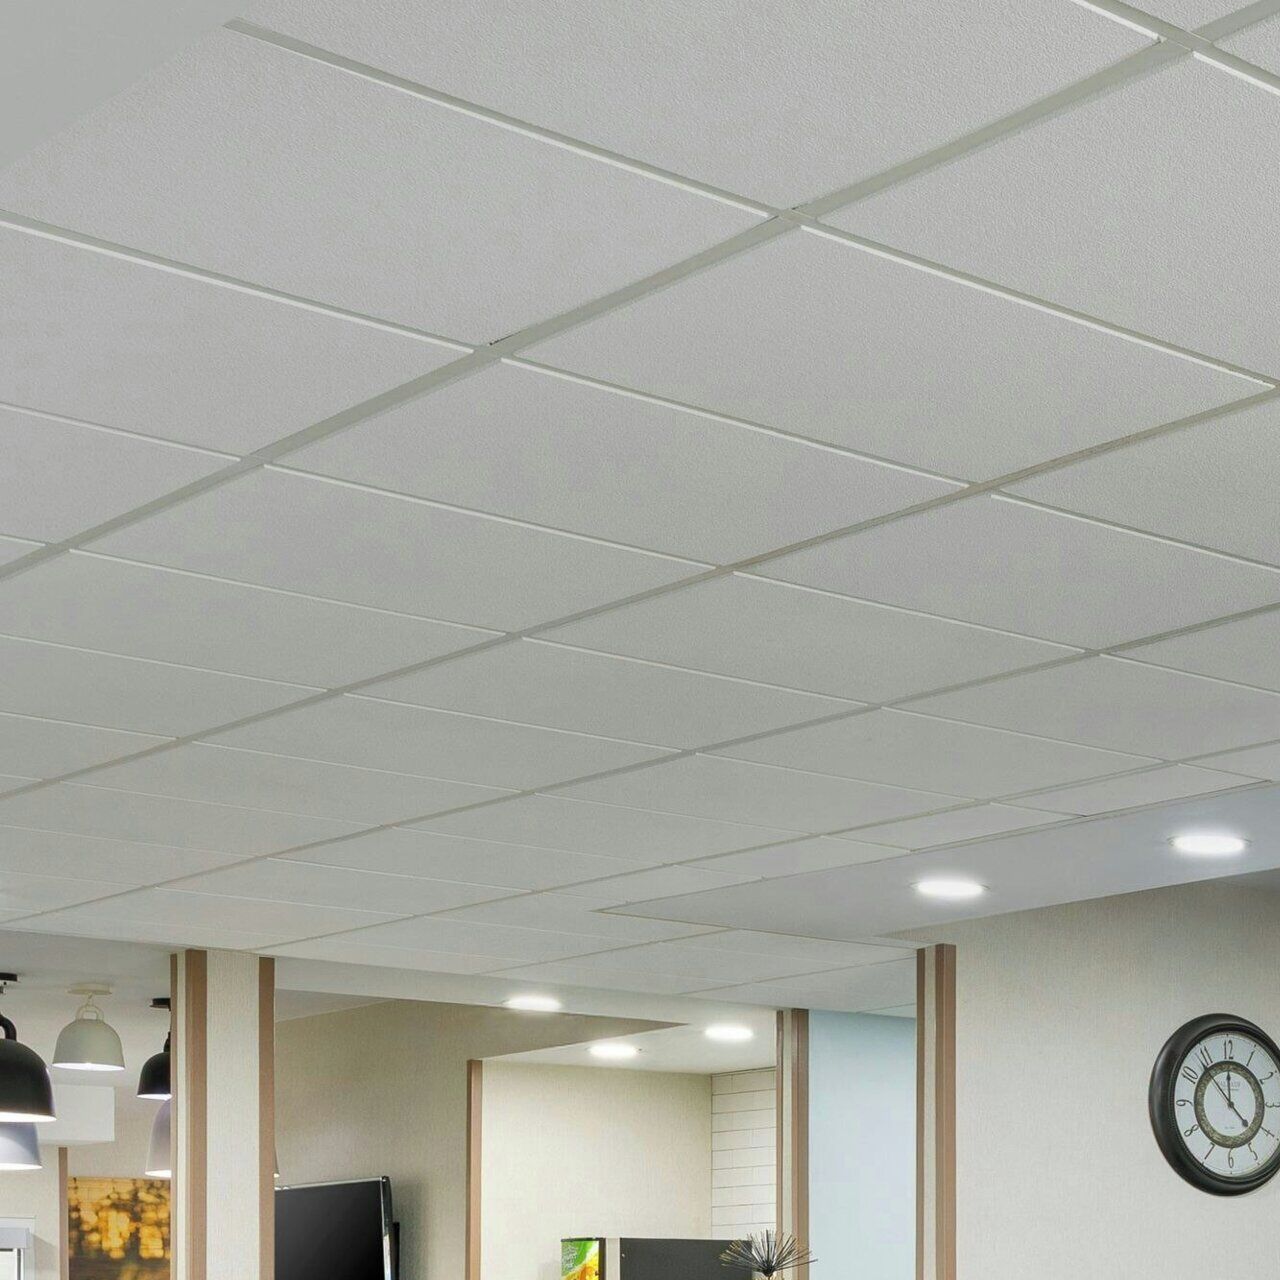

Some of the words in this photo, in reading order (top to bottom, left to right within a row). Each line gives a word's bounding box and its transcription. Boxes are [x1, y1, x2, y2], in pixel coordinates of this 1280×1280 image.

[1223, 1040, 1234, 1060] 12
[1181, 1065, 1199, 1085] 10
[1259, 1071, 1274, 1085] 2
[1175, 1098, 1194, 1107] 9
[1183, 1123, 1200, 1138] 8
[1227, 1148, 1235, 1168] 6
